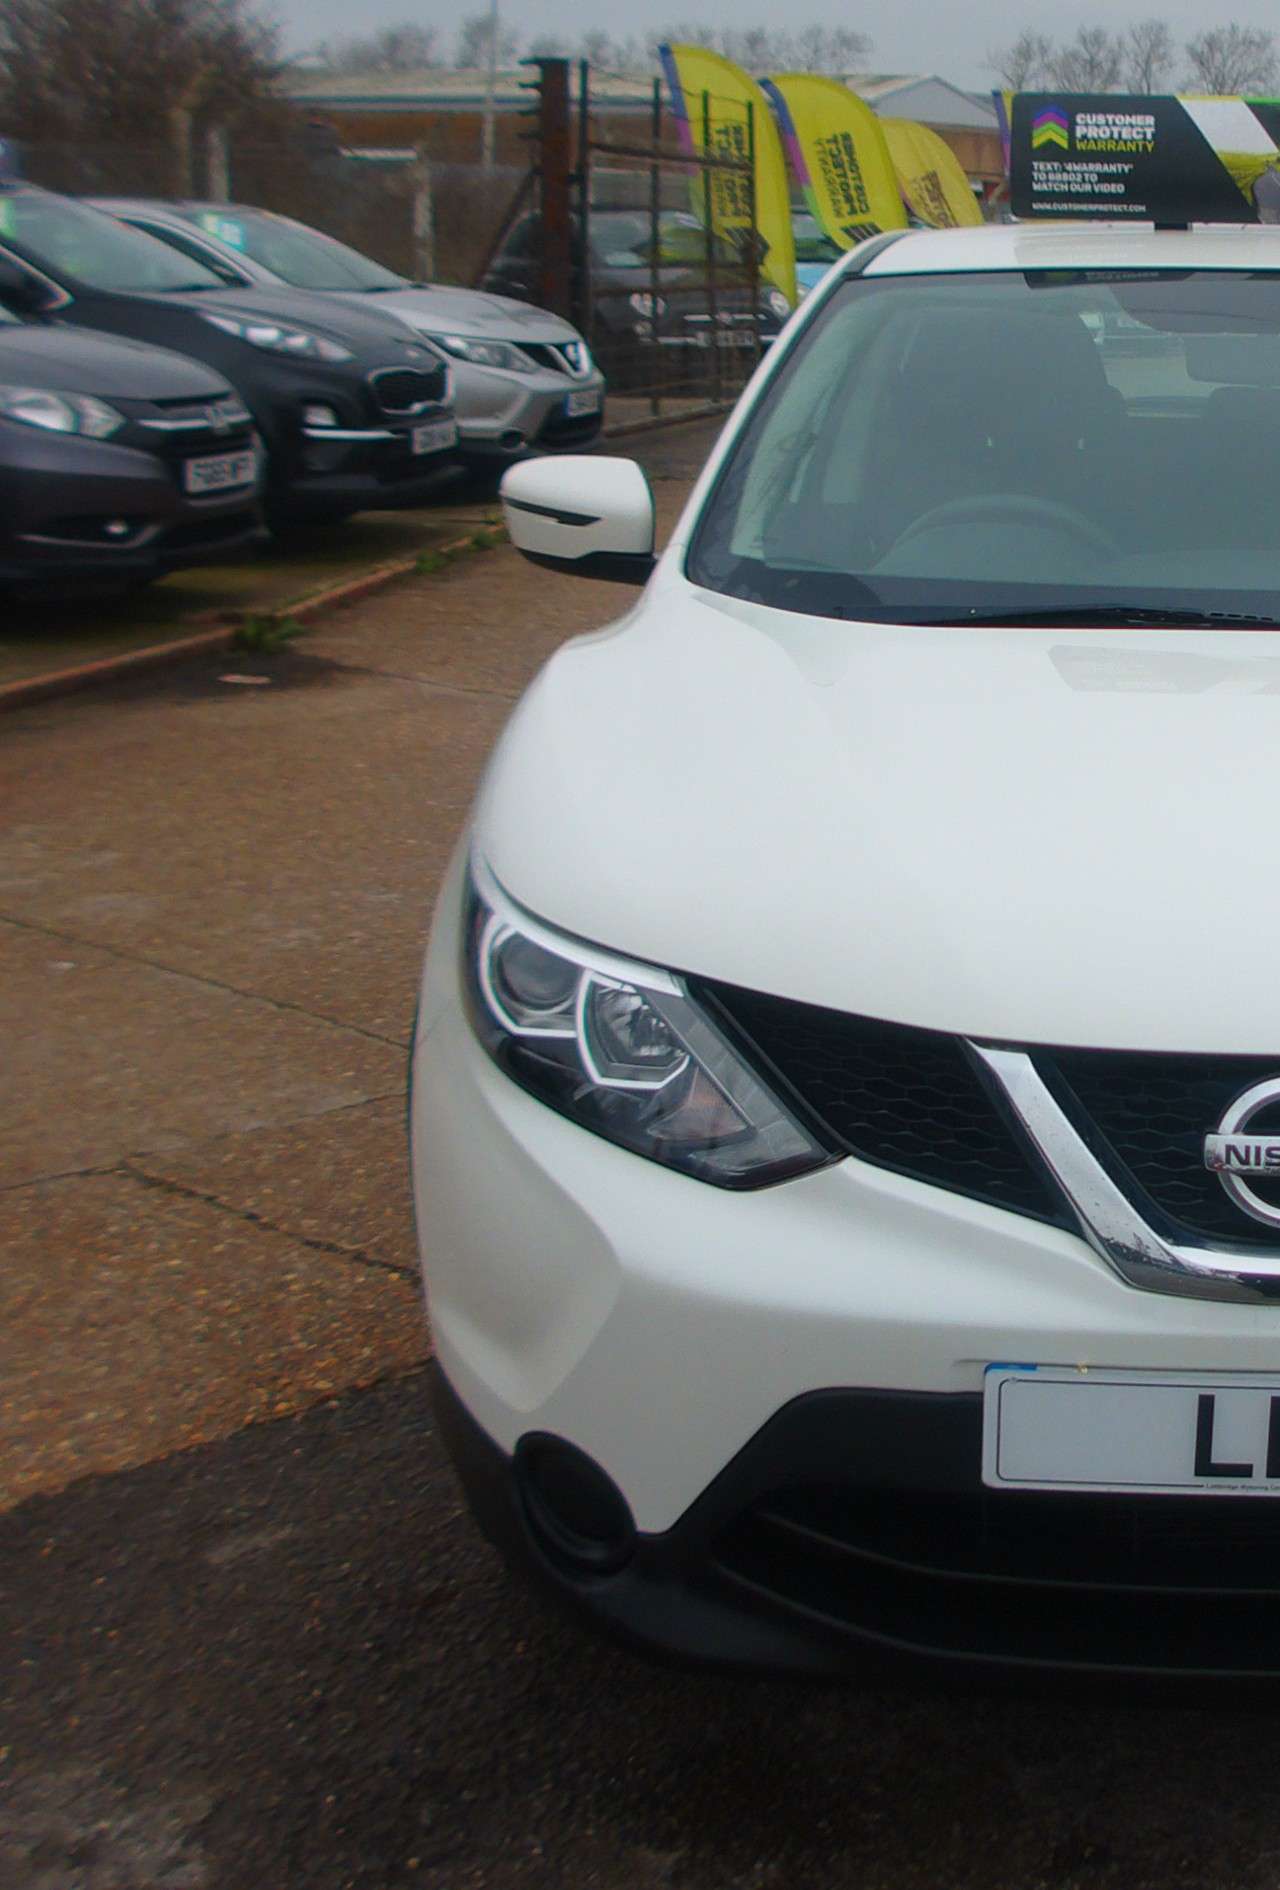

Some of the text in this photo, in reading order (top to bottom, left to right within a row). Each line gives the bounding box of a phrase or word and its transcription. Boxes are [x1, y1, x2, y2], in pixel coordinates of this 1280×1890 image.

[1075, 113, 1155, 126] CUSTOMER
[1075, 125, 1155, 140] PROTECT
[1076, 140, 1154, 152] WARRANTY
[1032, 161, 1062, 172] TEXT:
[1032, 171, 1046, 182] TO
[1084, 173, 1099, 183] TO
[1032, 182, 1125, 194] WATCH OUR VIDEO
